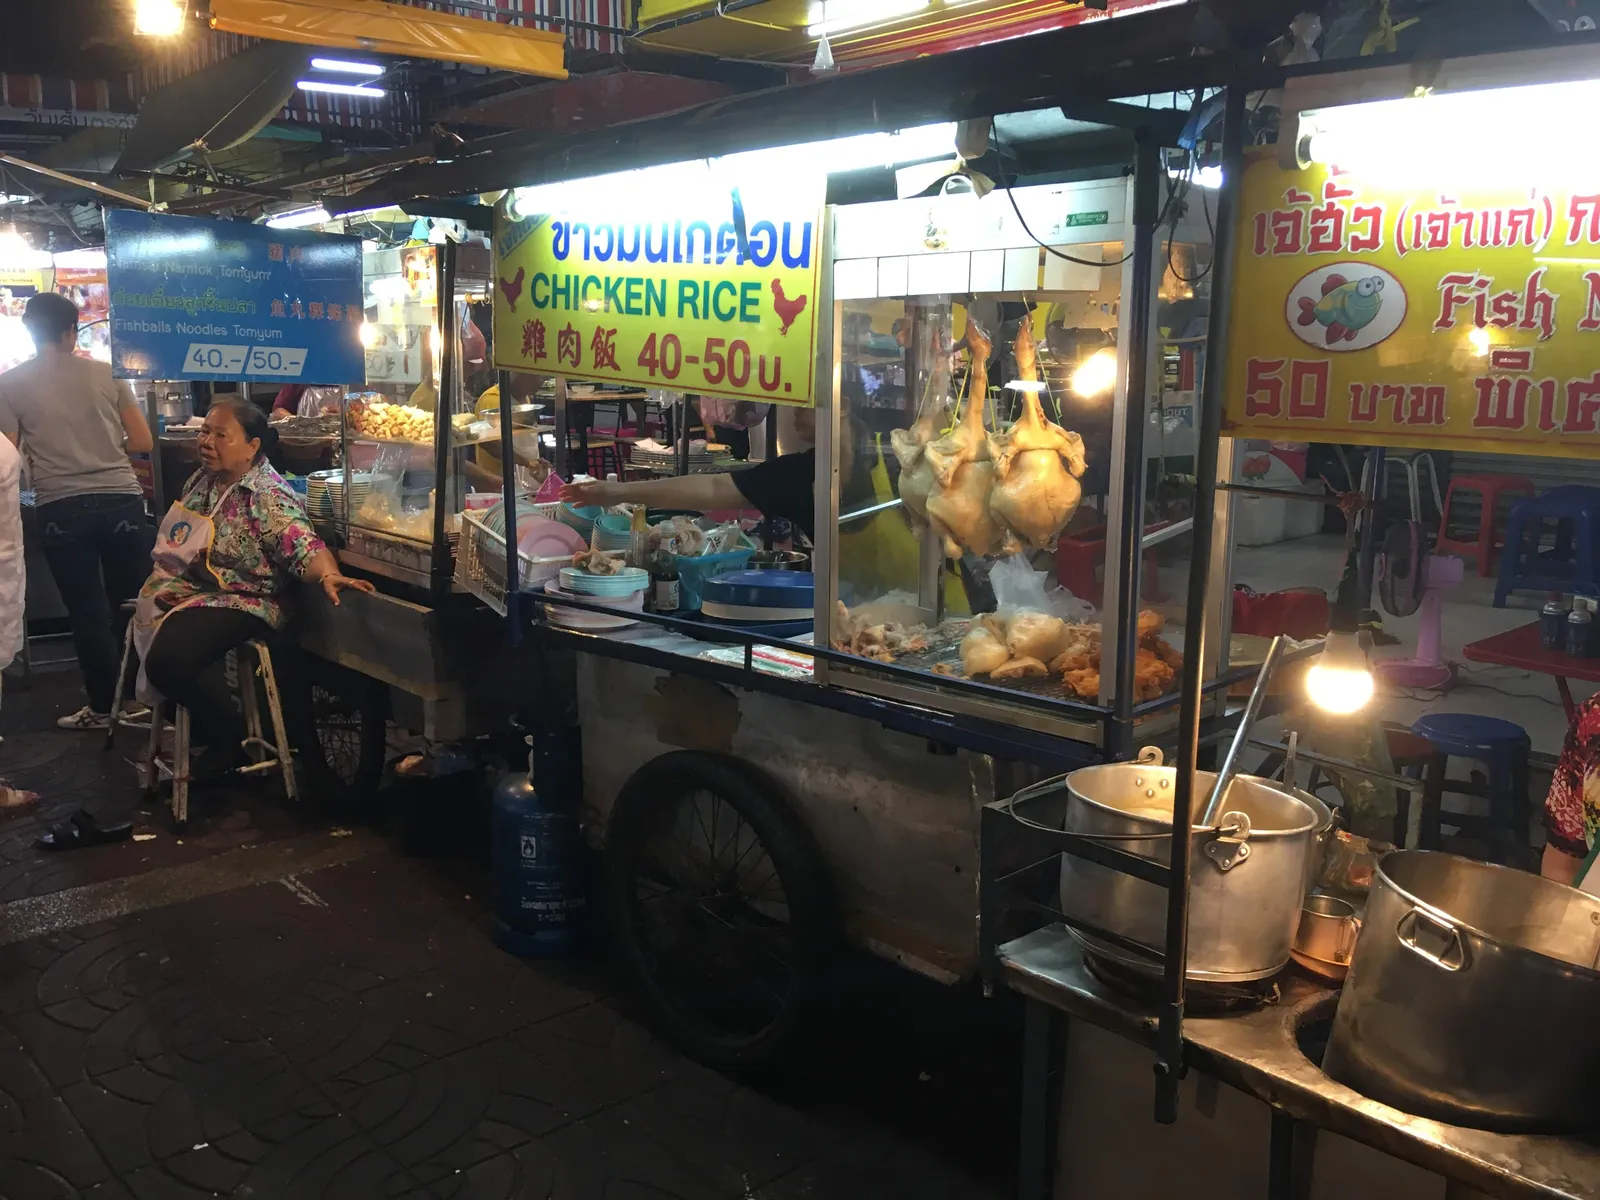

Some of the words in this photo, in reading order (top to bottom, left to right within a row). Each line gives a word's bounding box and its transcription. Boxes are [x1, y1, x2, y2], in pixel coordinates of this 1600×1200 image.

[219, 264, 270, 283] Tomyum
[530, 272, 667, 318] CHICKEN
[677, 279, 762, 323] RICE
[1434, 266, 1559, 341] Fish
[114, 318, 172, 334] Fishballs
[176, 320, 228, 336] Noodles
[233, 324, 283, 342] Tomyum
[520, 318, 621, 371] 雞肉飯
[1245, 357, 1332, 420] 50
[1349, 382, 1447, 426] บาท
